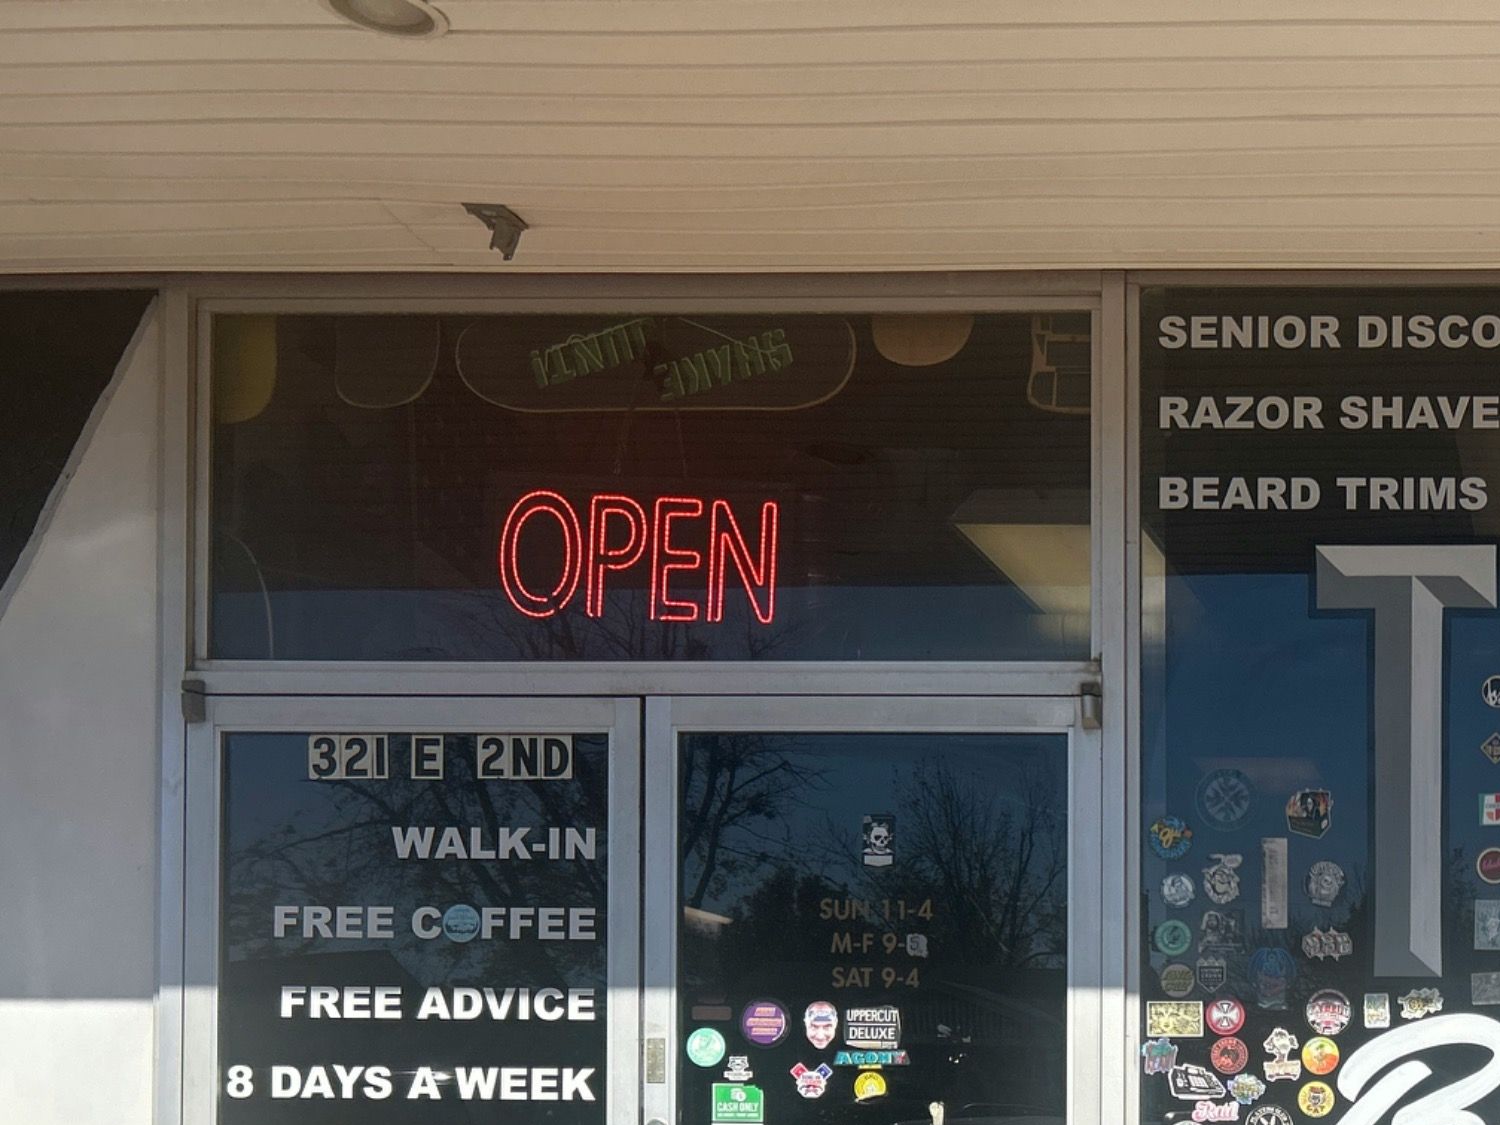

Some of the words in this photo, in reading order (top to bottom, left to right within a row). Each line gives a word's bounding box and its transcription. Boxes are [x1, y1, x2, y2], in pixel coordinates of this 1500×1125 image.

[1157, 314, 1342, 349] SENIOR
[1157, 395, 1325, 430] RAZOR
[1157, 476, 1321, 511] BEARD
[1336, 476, 1489, 511] TRIMS
[500, 490, 778, 624] OPEN
[312, 736, 387, 778] 321
[415, 736, 442, 778] E
[481, 736, 571, 778] 2ND
[392, 826, 597, 861] WALK-IN
[273, 905, 395, 940] FREE
[411, 906, 597, 941] CFFEE
[819, 899, 871, 921] SUN
[830, 933, 874, 954] M-F
[831, 967, 872, 989] SAT
[881, 967, 921, 989] 9-4
[279, 985, 403, 1020] FREE
[416, 987, 597, 1021] ADVICE
[846, 1008, 898, 1022] UPPERCUT
[848, 1027, 896, 1040] DELUXE
[226, 1065, 254, 1100] 8
[271, 1065, 393, 1100] DAYS
[407, 1066, 443, 1101] A
[455, 1067, 597, 1102] WEEK
[716, 1102, 739, 1113] CASH
[739, 1102, 760, 1113] ONLY
